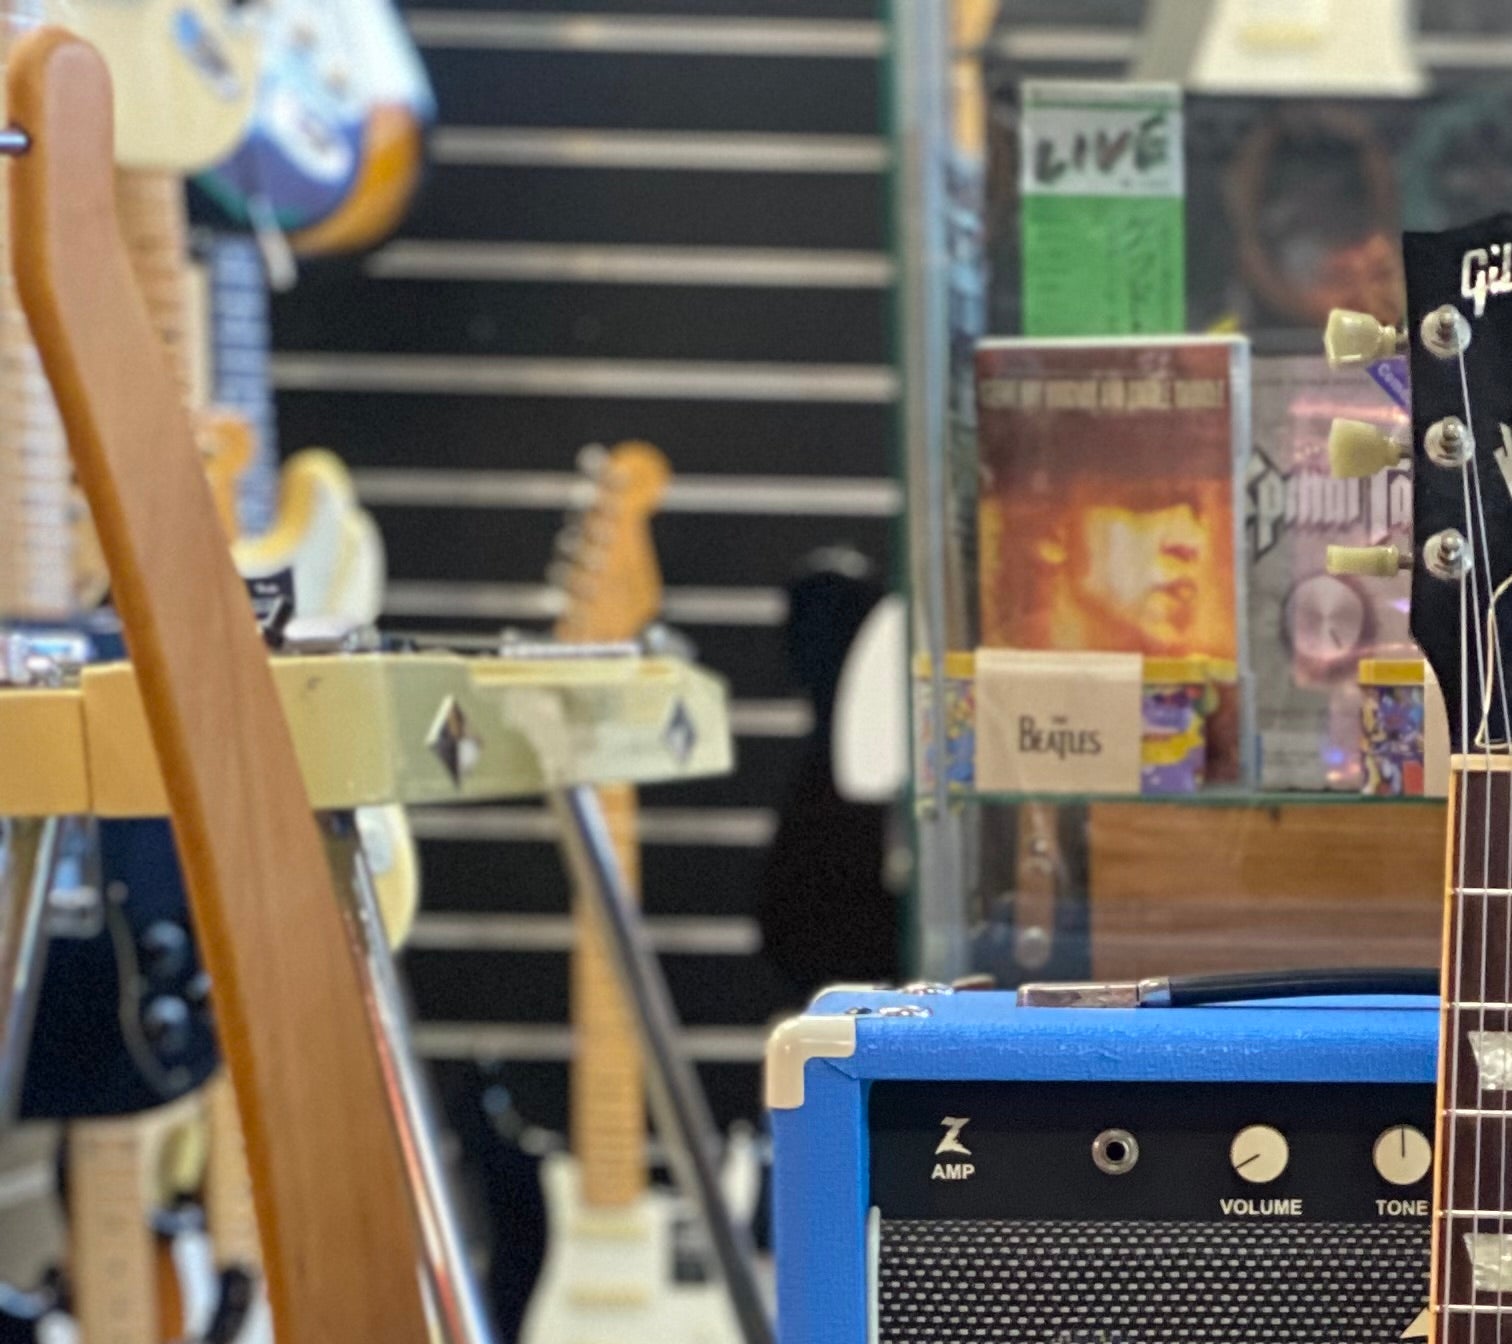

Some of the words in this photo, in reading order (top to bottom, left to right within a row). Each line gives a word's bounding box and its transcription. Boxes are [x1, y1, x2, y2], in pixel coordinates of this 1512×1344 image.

[1034, 113, 1170, 185] LIVE
[1018, 714, 1102, 761] BEATLES
[931, 1162, 976, 1181] AMP
[1219, 1198, 1304, 1217] VOLUME
[1375, 1199, 1429, 1217] TONE
